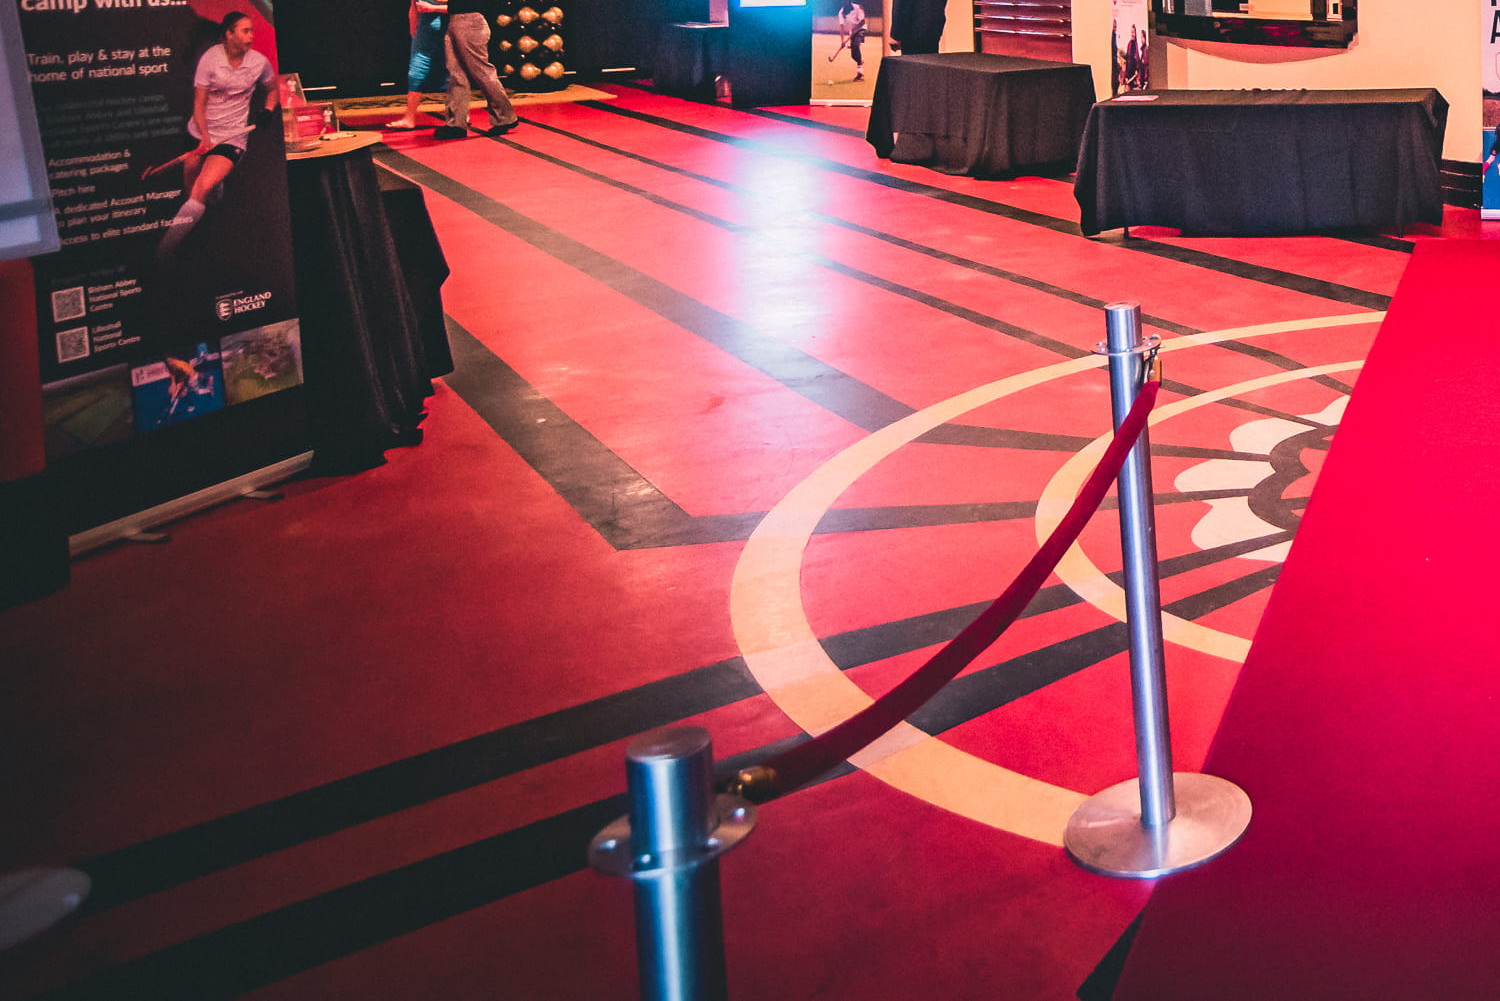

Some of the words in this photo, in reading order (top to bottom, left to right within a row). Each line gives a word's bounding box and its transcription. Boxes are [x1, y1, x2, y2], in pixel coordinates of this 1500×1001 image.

[68, 50, 94, 65] play
[97, 48, 107, 61] &
[111, 48, 135, 61] stay
[138, 47, 150, 58] at
[152, 45, 171, 57] the
[71, 68, 84, 80] of
[88, 65, 136, 79] national
[138, 62, 168, 76] sport
[233, 291, 271, 306] ENGLAND
[234, 300, 266, 315] HOCKEY
